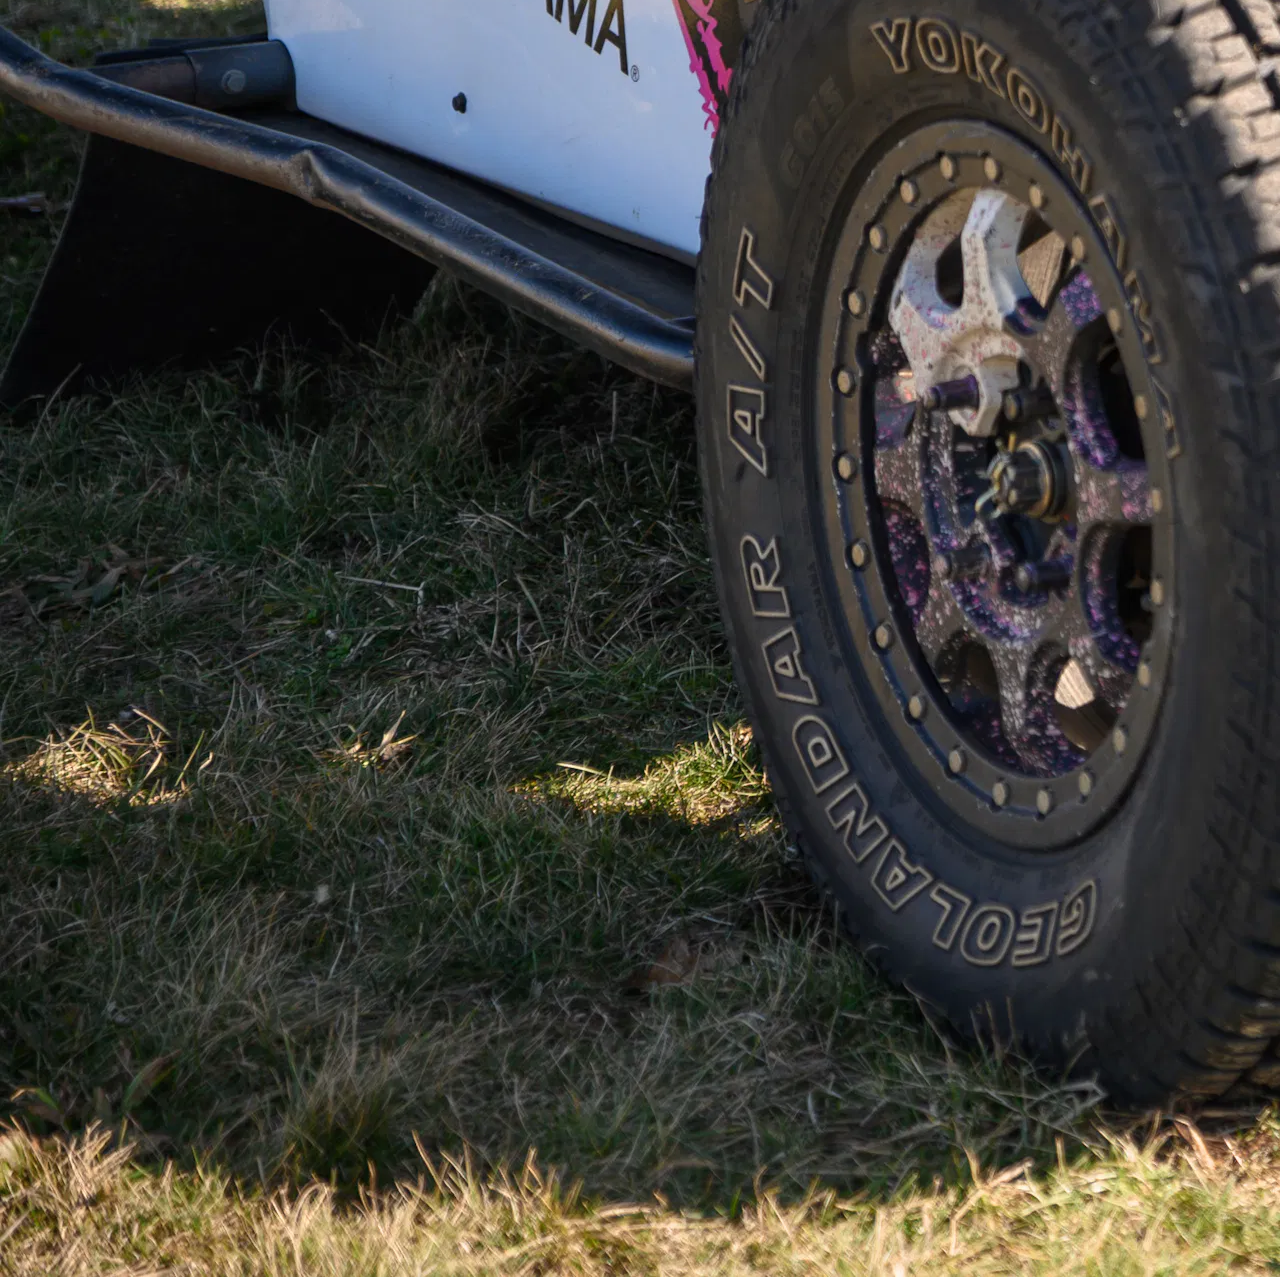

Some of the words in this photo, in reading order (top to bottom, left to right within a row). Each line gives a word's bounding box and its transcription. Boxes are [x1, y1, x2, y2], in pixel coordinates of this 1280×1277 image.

[726, 226, 775, 479] A/T
[870, 18, 1182, 459] YOKOHAMA
[738, 533, 1098, 968] GEOLANDAR
